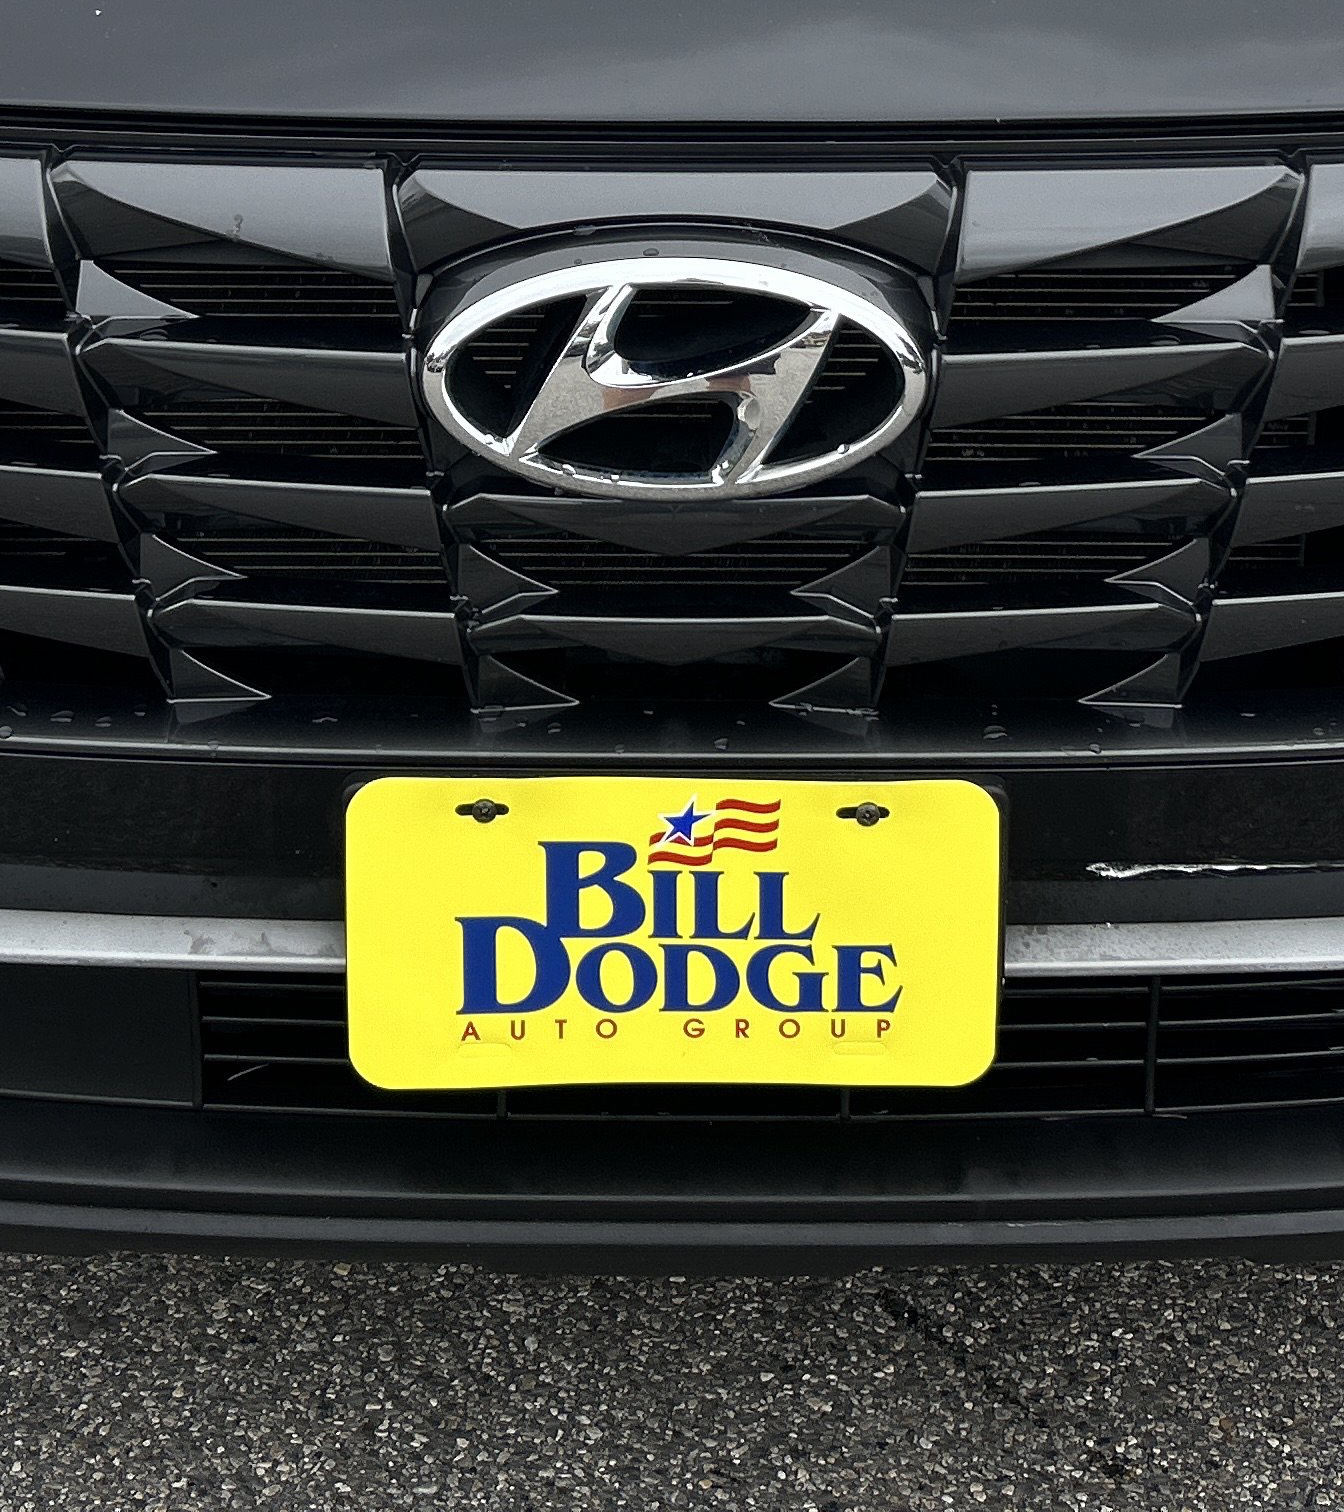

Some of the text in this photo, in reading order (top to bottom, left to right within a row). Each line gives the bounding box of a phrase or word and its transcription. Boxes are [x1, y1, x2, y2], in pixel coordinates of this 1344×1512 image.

[537, 840, 821, 941] BILL
[454, 916, 903, 1015] DODGE
[461, 1018, 891, 1041] AUTO GROUP
